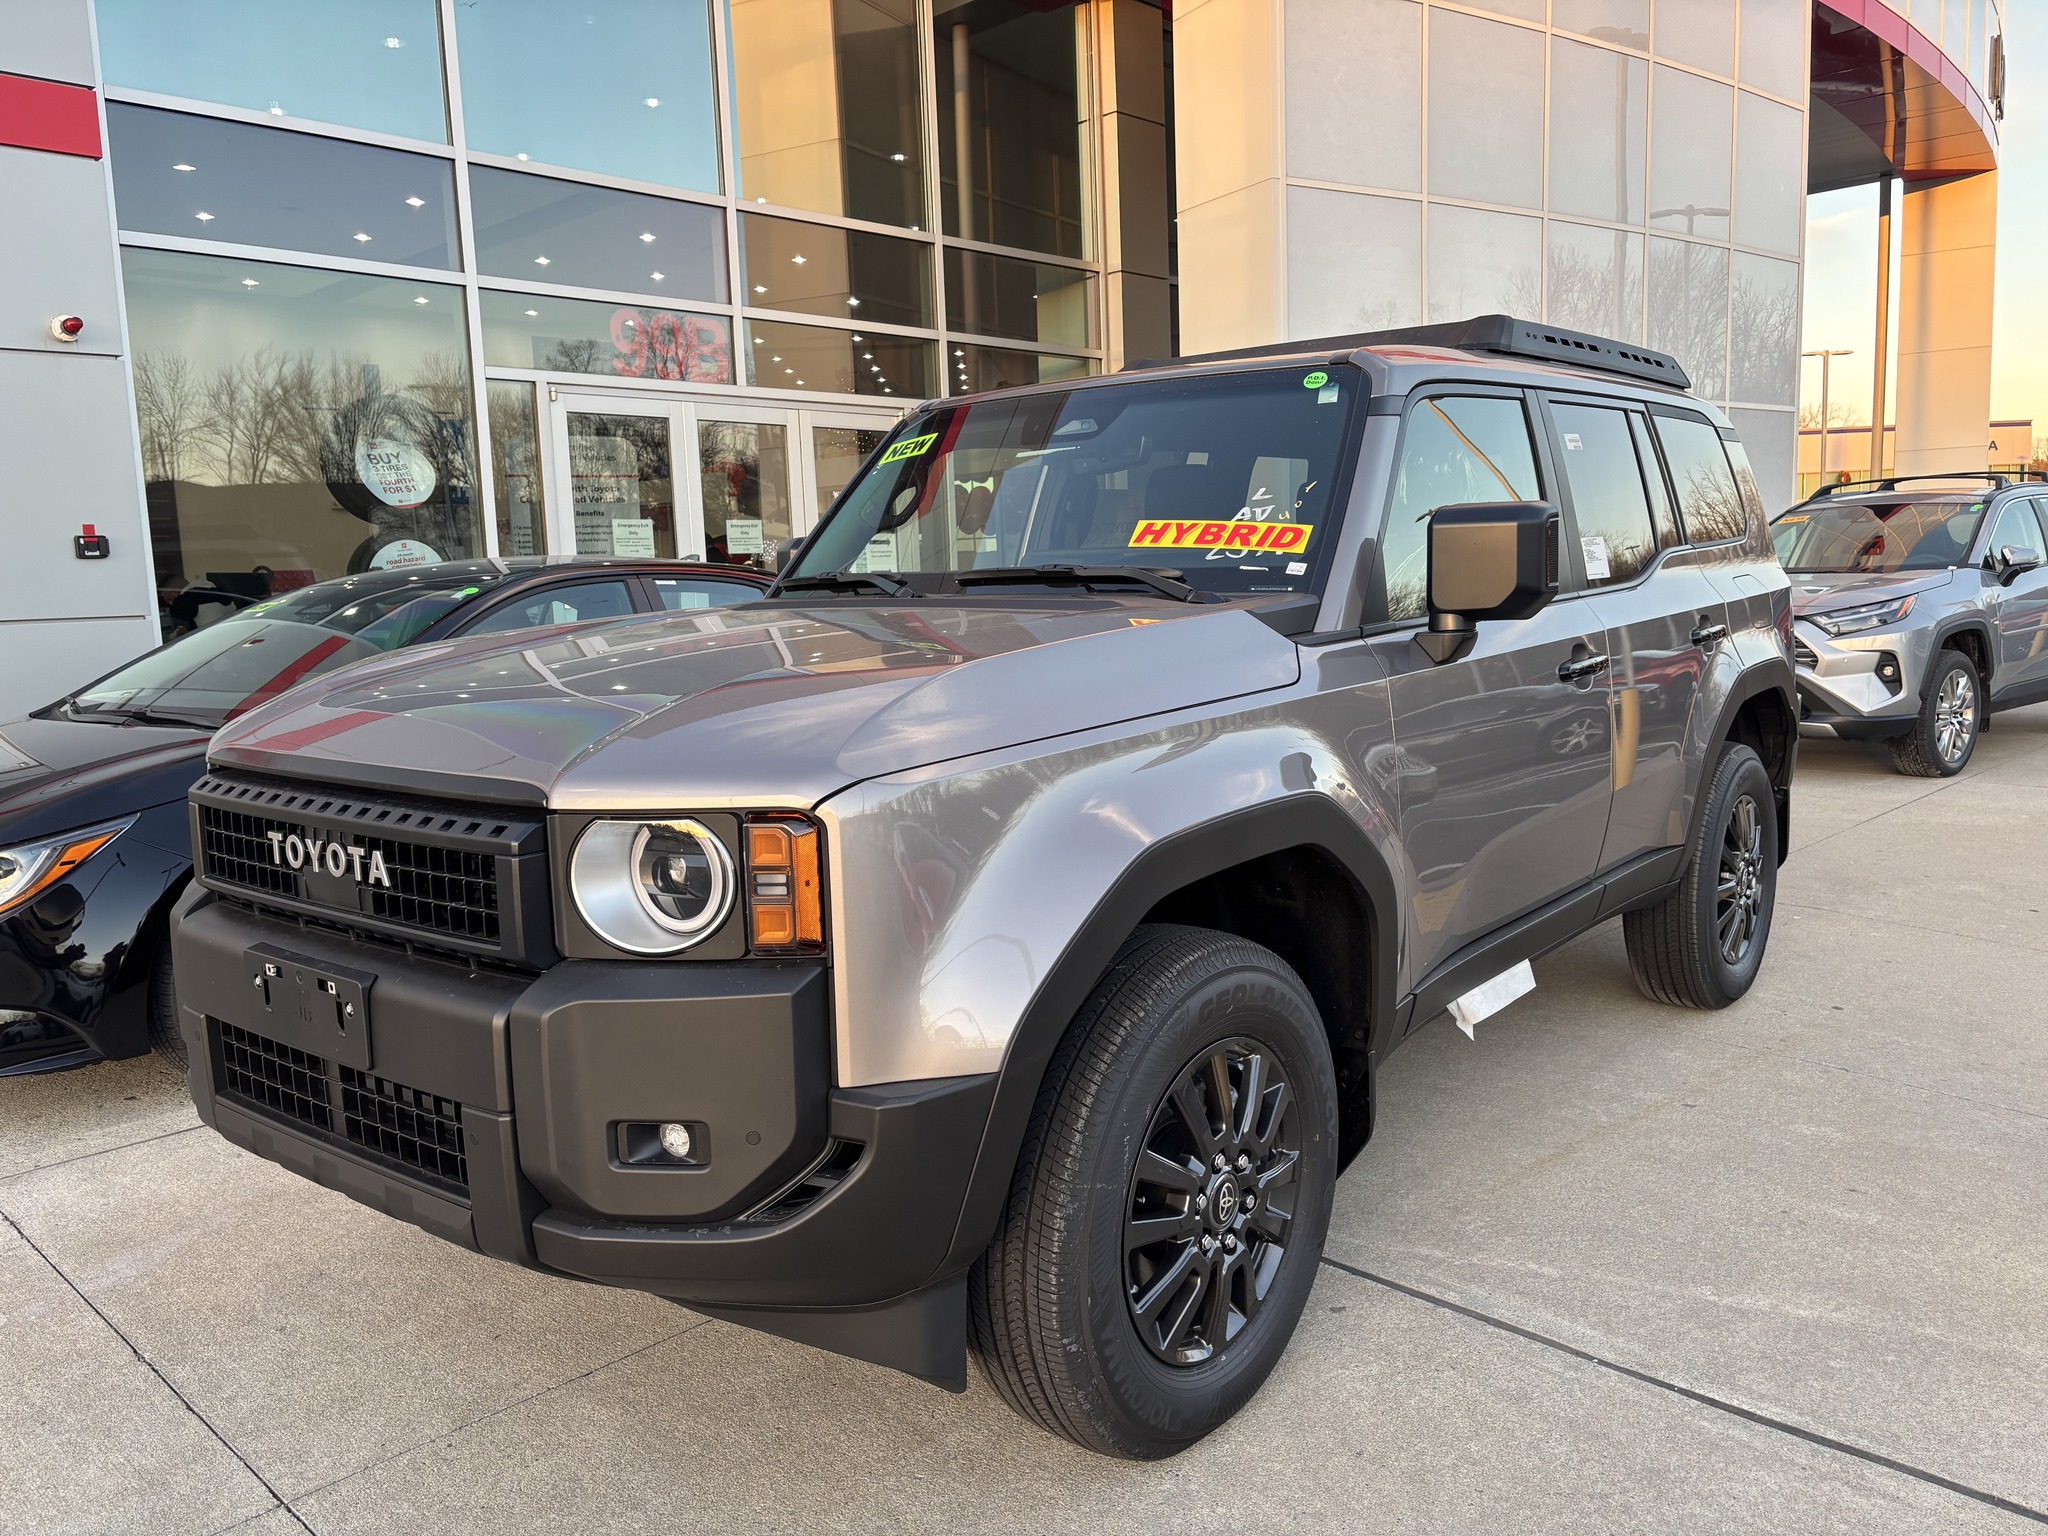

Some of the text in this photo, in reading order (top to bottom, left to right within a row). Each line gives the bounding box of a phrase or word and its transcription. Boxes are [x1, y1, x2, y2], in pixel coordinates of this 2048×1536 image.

[883, 436, 933, 461] NEW
[367, 451, 401, 465] BUY
[372, 463, 409, 473] 3 TIRES
[394, 471, 412, 479] THE
[379, 477, 415, 486] FOURTH
[382, 486, 404, 495] FOR
[589, 484, 620, 494] Toyota
[588, 495, 626, 504] Vehicles
[1133, 522, 1308, 550] HYBRID
[386, 555, 426, 566] road hazard
[268, 831, 390, 888] TOYOTA
